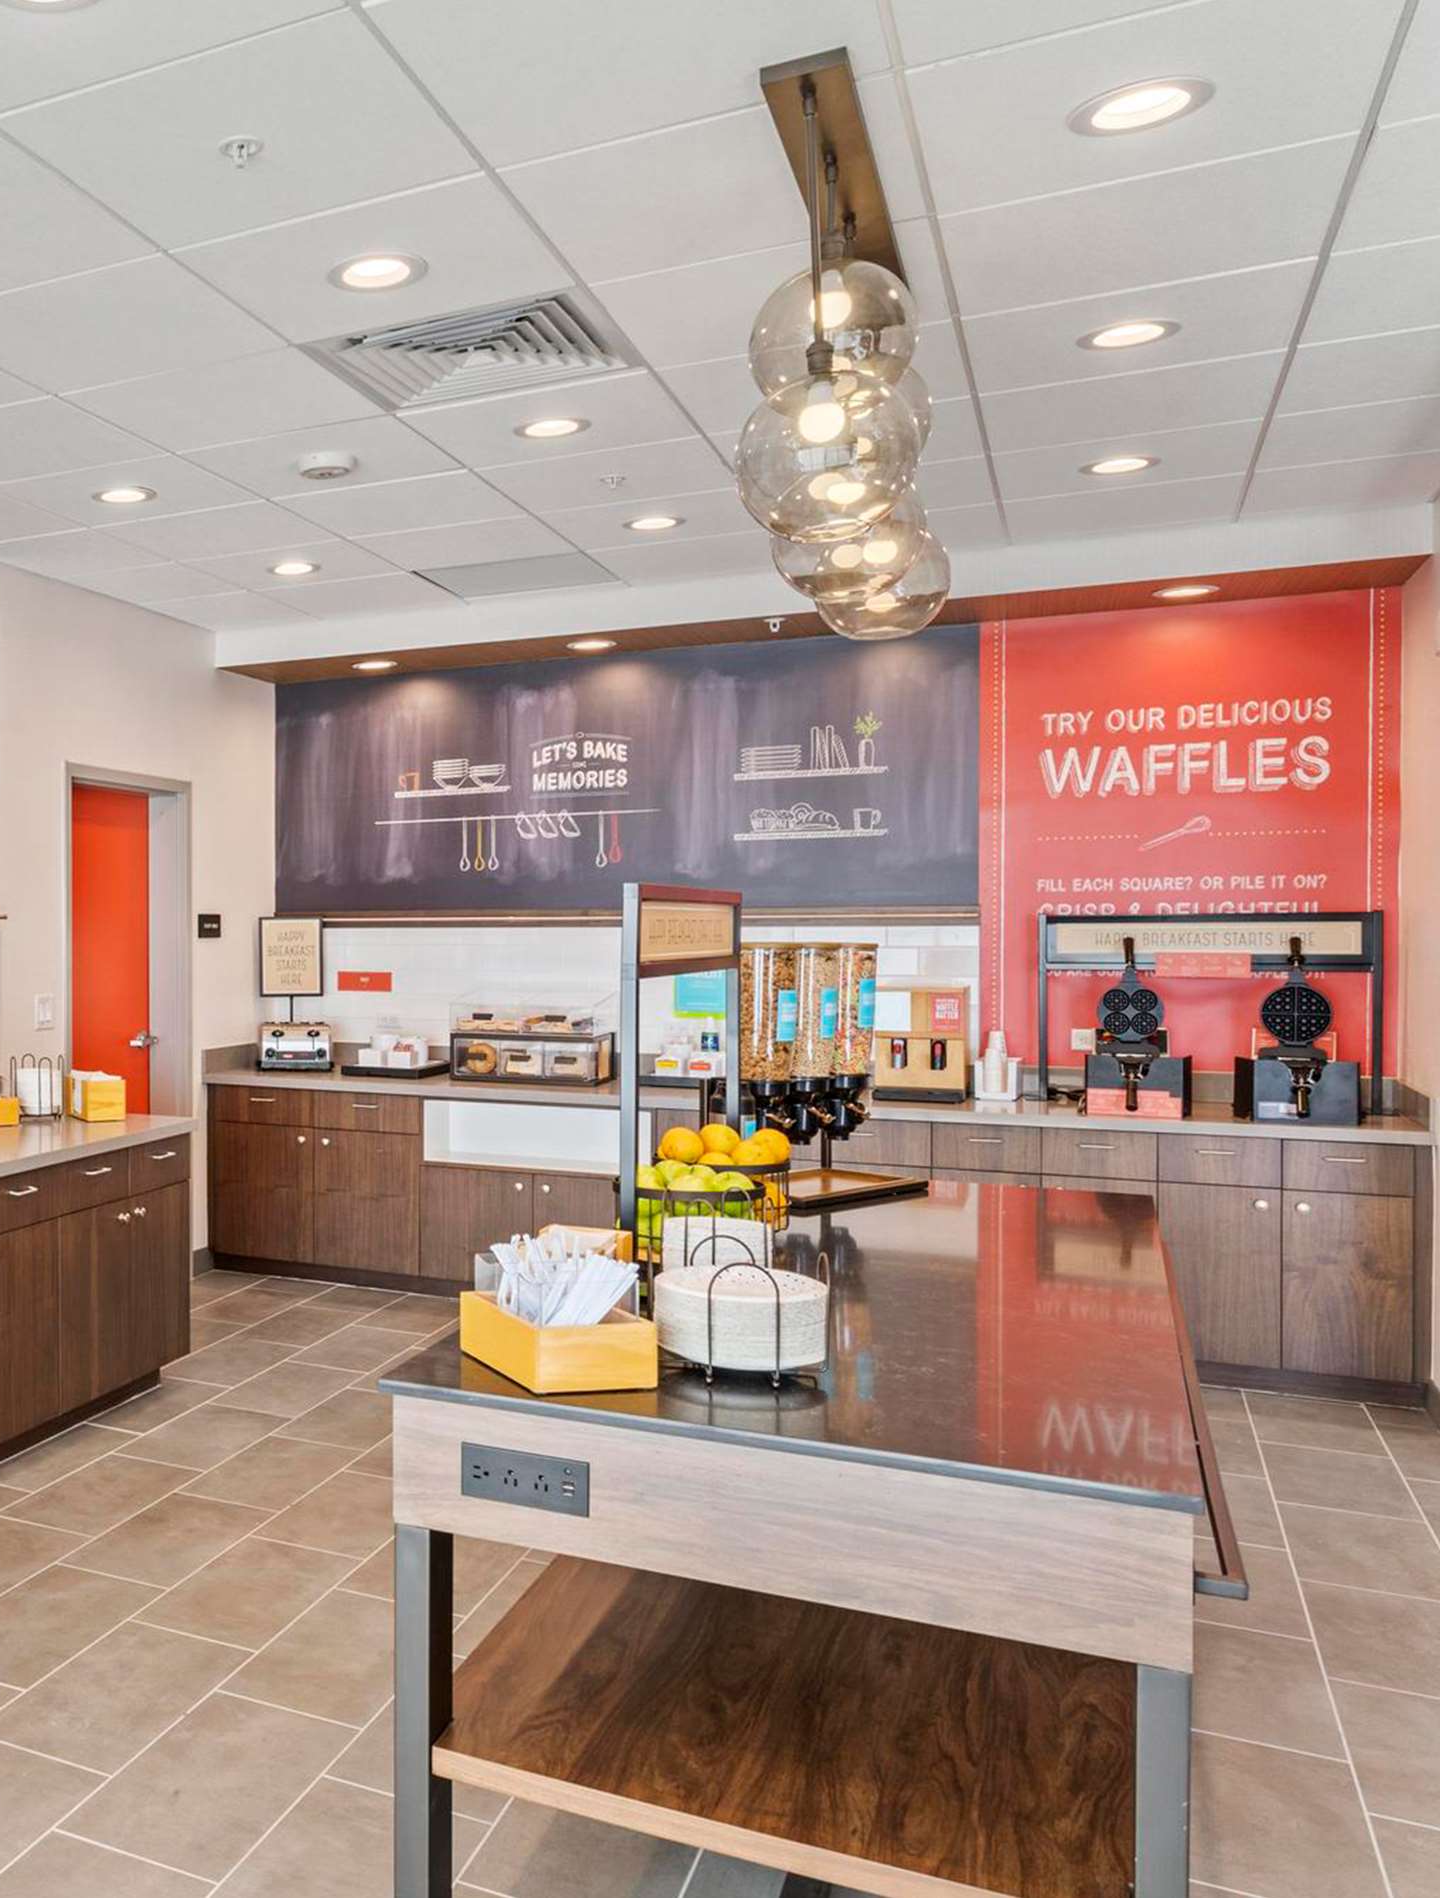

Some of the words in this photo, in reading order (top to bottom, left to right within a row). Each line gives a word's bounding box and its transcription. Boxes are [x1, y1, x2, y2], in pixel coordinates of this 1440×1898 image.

[1042, 710, 1093, 736] TRY
[1105, 707, 1165, 734] OUR
[1177, 697, 1332, 730] DELICIOUS
[532, 741, 577, 768] LET'S
[583, 740, 628, 762] BAKE
[1039, 735, 1332, 799] WAFFLES
[532, 768, 628, 792] MEMORIES
[1037, 878, 1066, 892] FILL
[1072, 877, 1113, 891] EACH
[1120, 876, 1193, 892] SQUARE?
[1200, 876, 1223, 889] OR
[1231, 875, 1264, 889] PILE
[1272, 875, 1286, 889] IT
[1293, 874, 1327, 889] ON?
[1143, 932, 1217, 946] BREAKFAST
[1224, 931, 1273, 946] STARTS
[268, 945, 315, 956] BREAKFAST
[277, 959, 306, 971] STARTS
[281, 973, 302, 984] HERE
